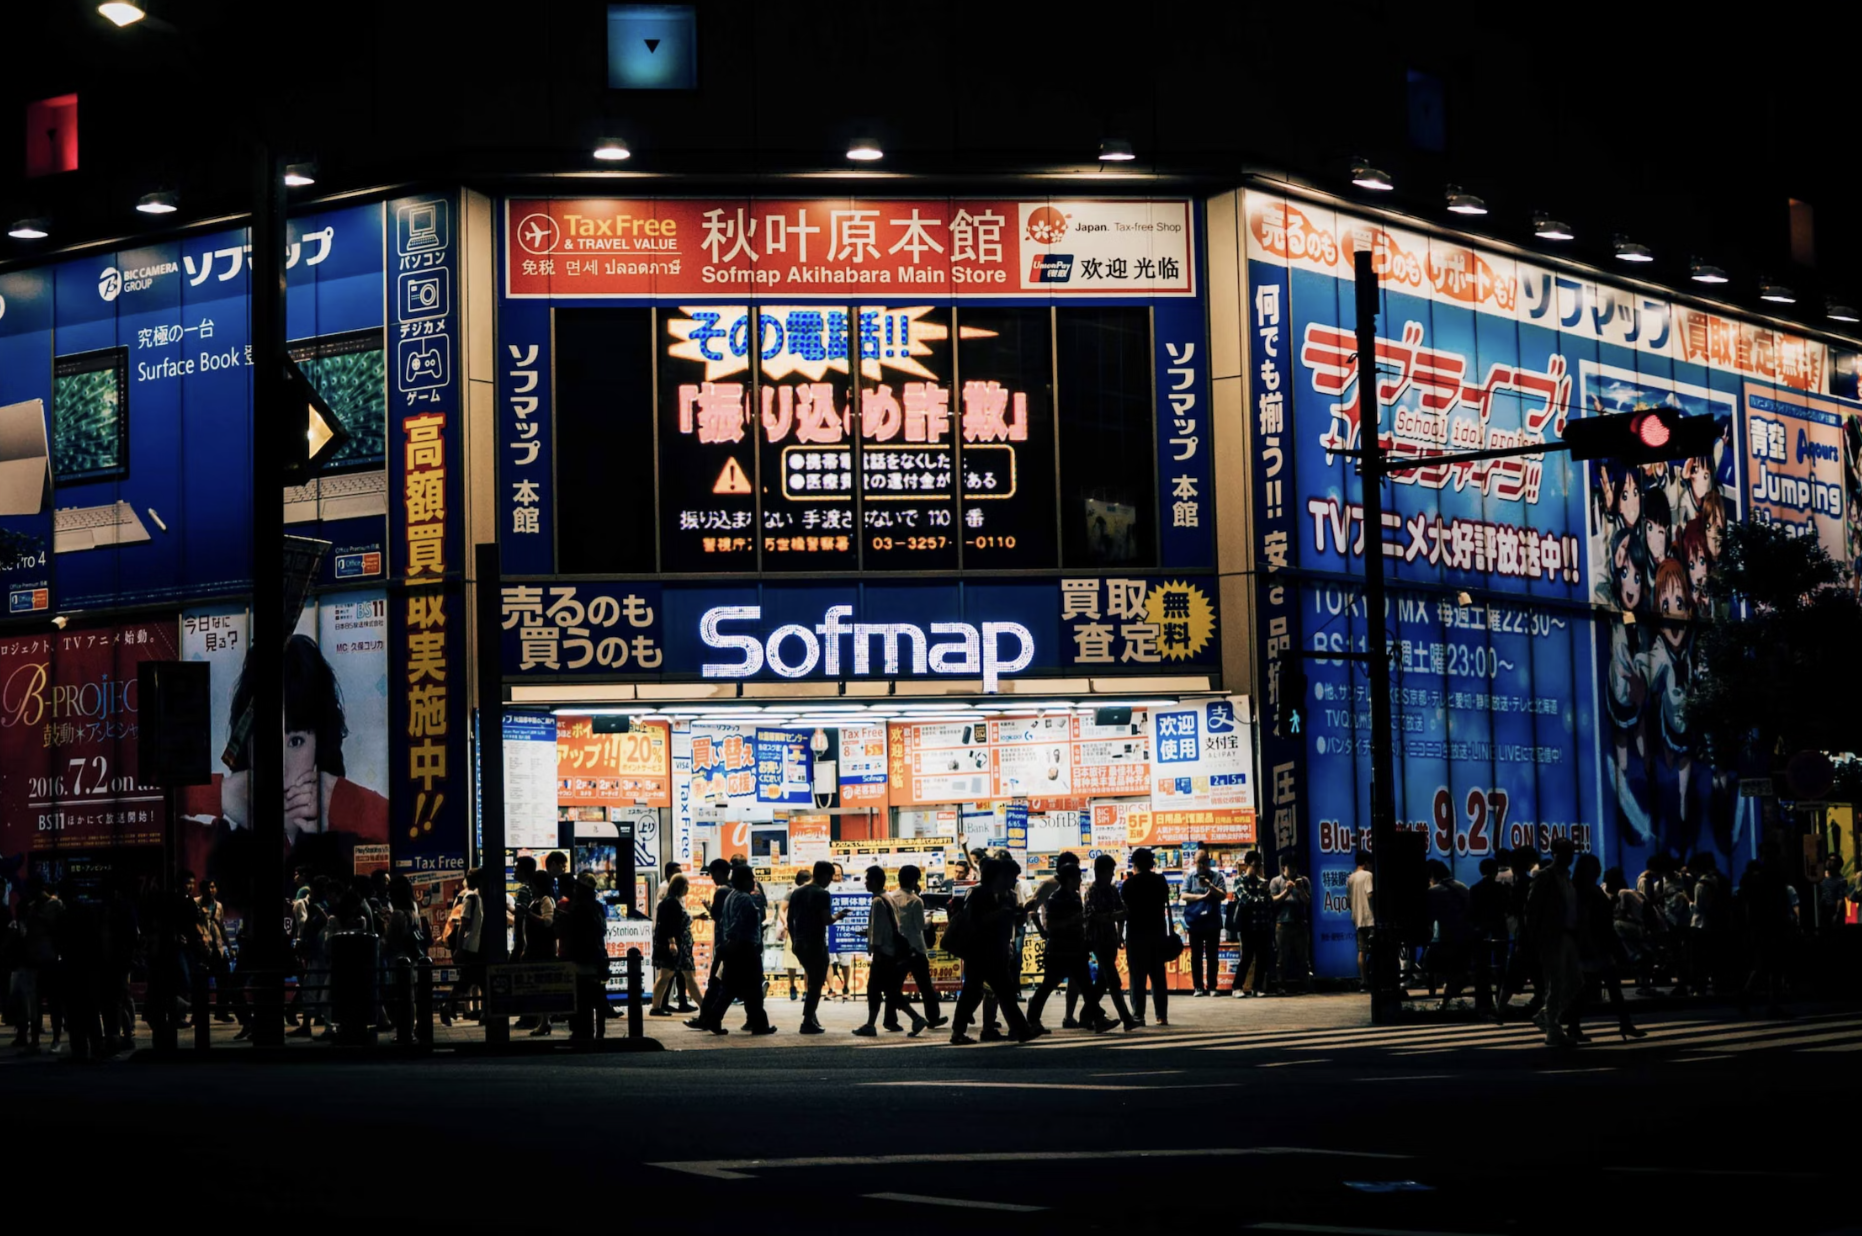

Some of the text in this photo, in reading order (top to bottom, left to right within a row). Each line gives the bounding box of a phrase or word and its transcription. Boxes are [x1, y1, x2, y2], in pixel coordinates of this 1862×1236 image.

[563, 215, 677, 237] Tax Free
[700, 207, 1006, 264] 秋叶原本館
[1075, 222, 1181, 234] Japan. Tax-free Shop
[564, 238, 678, 250] & TRAVEL VALUE
[124, 262, 178, 280] BIC CAMERA
[399, 251, 447, 271] パソコン
[522, 260, 556, 276] 免税
[566, 259, 599, 276] 면세
[124, 279, 152, 292] GROUP
[701, 266, 1007, 287] Sofmap Akihabara Main Store
[1524, 273, 1671, 349] ソフマップ
[138, 318, 214, 350] 究極の一台
[399, 320, 447, 338] デジカメ
[689, 311, 910, 361] その電話!!
[138, 356, 196, 382] Surface
[200, 346, 240, 372] Book
[406, 389, 441, 406] ゲーム
[1255, 284, 1284, 519] 何でも揃う!!
[508, 344, 541, 534] ソフマップ 本館
[1165, 342, 1199, 528] ソフマップ 本館
[1397, 411, 1485, 448] School idol
[1752, 465, 1842, 519] Jumping
[37, 551, 47, 567] 4
[356, 601, 384, 619] BS11
[501, 585, 654, 631] 売るのも
[1061, 579, 1149, 620] 買取
[1398, 598, 1428, 624] MX
[184, 615, 231, 635] 今日なに
[1162, 590, 1191, 651] 無料
[519, 626, 663, 671] 買うのも
[700, 605, 1034, 693] Sofmap
[1073, 621, 1162, 663] 査定
[842, 727, 883, 740] Tax Free
[1159, 714, 1196, 737] 欢迎
[693, 737, 755, 770] 買い替え
[1160, 737, 1197, 761] 使用
[1204, 735, 1238, 751] 支付宝
[676, 761, 689, 769] VISA
[638, 822, 656, 834] 上り
[680, 783, 690, 859] Tax Free
[1039, 812, 1080, 829] SoftB
[1129, 814, 1149, 828] 5F
[1433, 787, 1508, 857] 9.27
[1319, 822, 1373, 854] Blu-ra
[1511, 823, 1533, 849] ON
[414, 855, 464, 870] Tax Free
